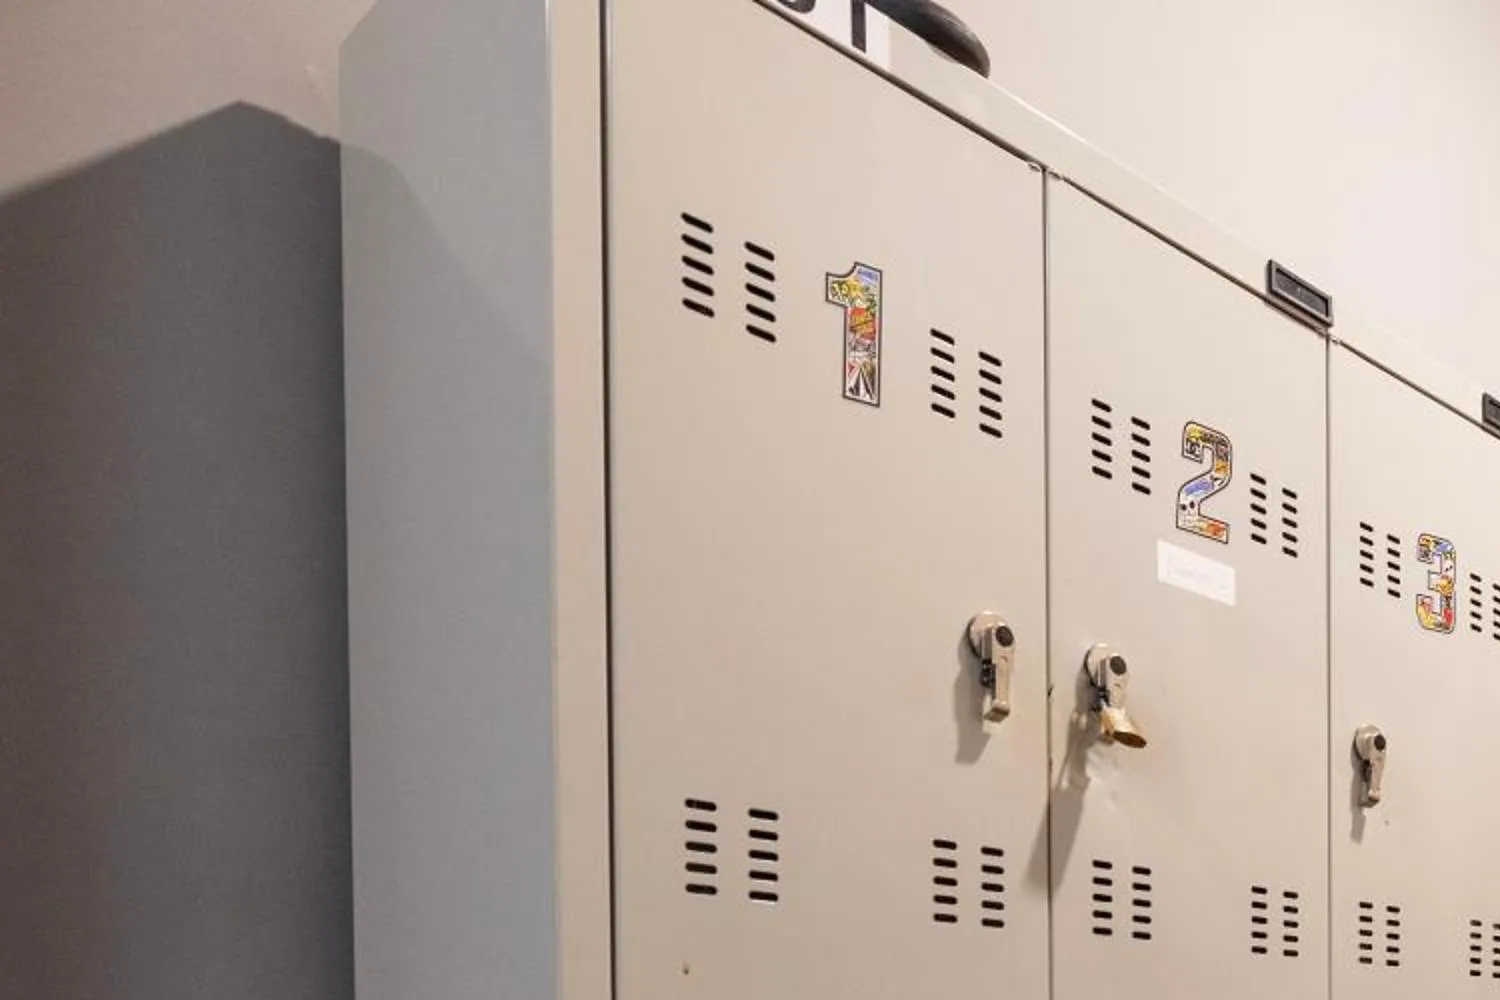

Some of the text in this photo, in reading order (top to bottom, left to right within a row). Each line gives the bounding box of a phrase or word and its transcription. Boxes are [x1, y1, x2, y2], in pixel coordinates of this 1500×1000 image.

[825, 262, 882, 408] 1
[1176, 421, 1233, 544] 2
[1416, 533, 1456, 634] 3
